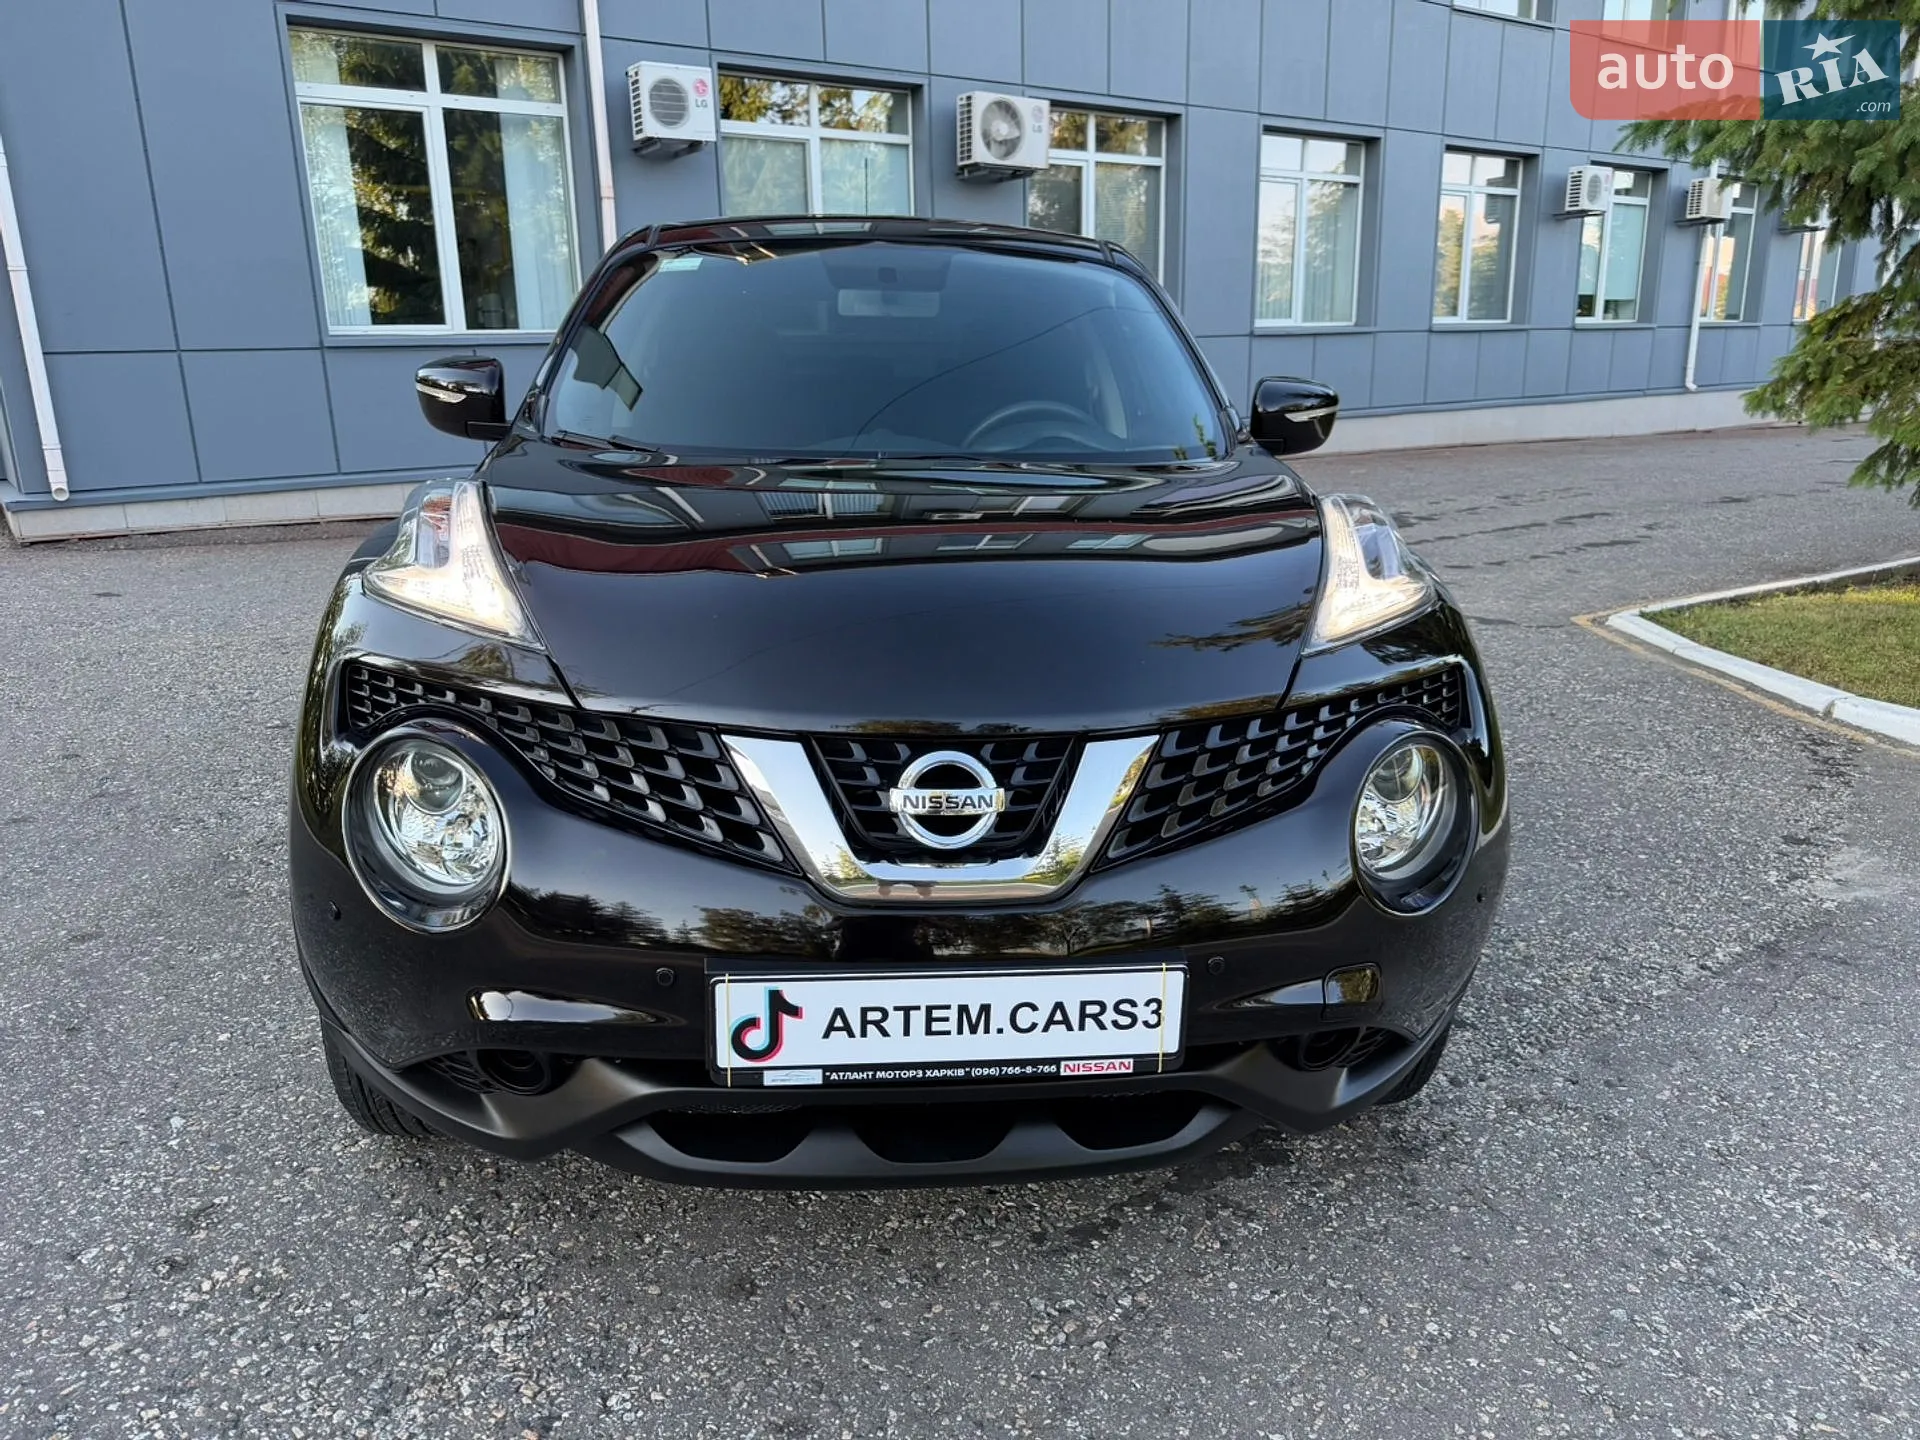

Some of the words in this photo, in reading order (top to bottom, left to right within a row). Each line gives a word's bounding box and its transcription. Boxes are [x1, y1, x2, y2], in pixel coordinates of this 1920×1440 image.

[695, 99, 708, 108] LG
[1032, 123, 1043, 134] LG
[903, 795, 993, 809] NISSAN
[821, 998, 1163, 1039] ARTEM.CARS3
[971, 1066, 999, 1077] (096)
[1001, 1065, 1057, 1075] 766-8-766
[1063, 1061, 1132, 1073] NISSAN
